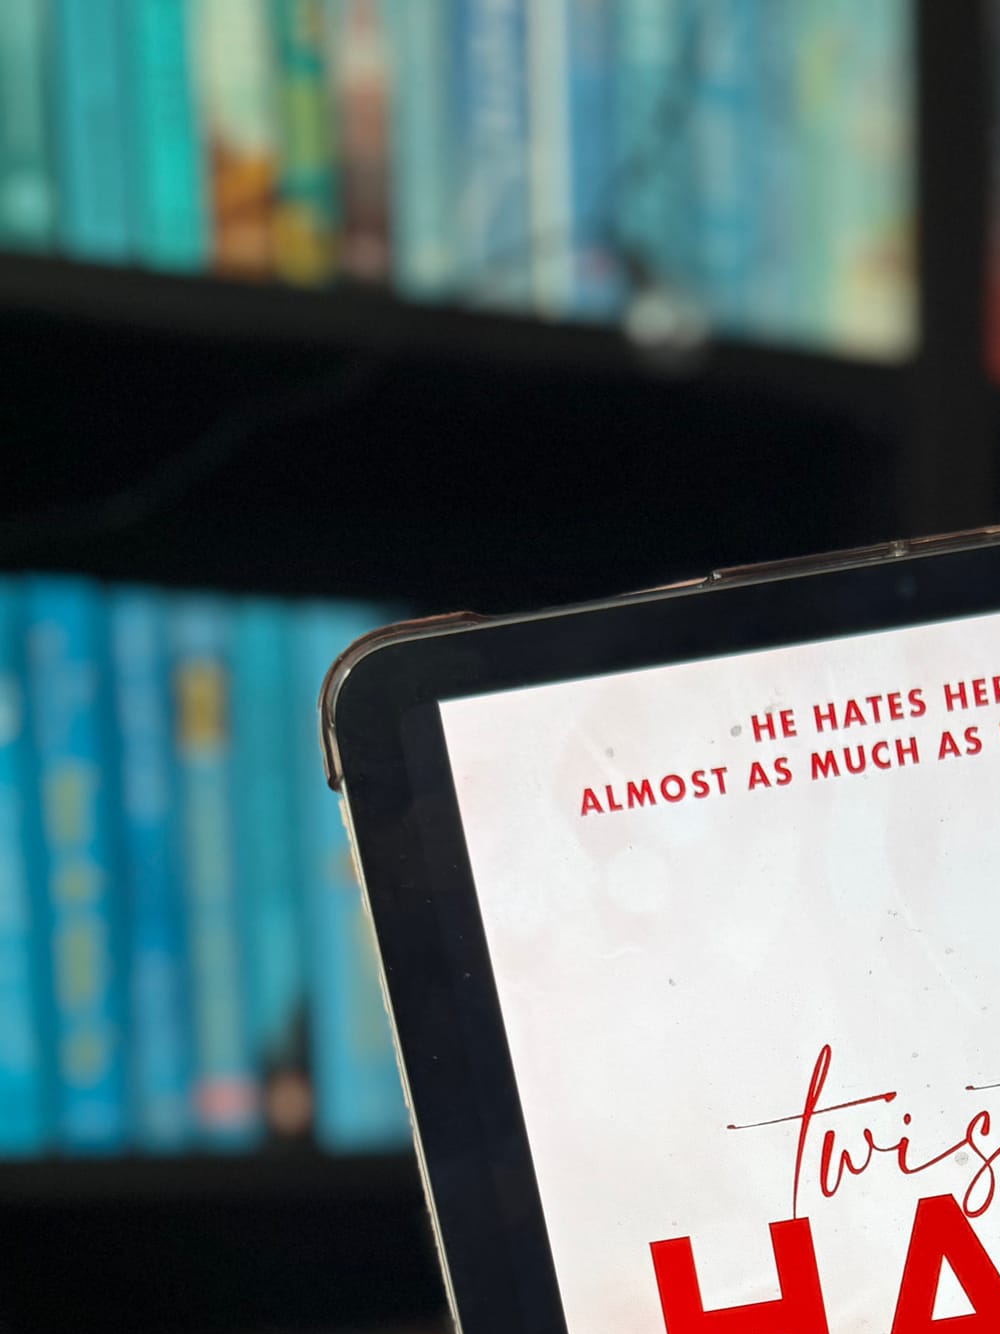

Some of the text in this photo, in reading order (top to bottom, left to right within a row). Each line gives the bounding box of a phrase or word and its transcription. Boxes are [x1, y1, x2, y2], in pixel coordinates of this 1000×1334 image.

[751, 709, 796, 742] HE
[813, 688, 926, 732] HATES
[581, 767, 727, 816] ALMOST
[748, 757, 792, 790] AS
[810, 737, 920, 780] MUCH
[938, 727, 982, 760] AS
